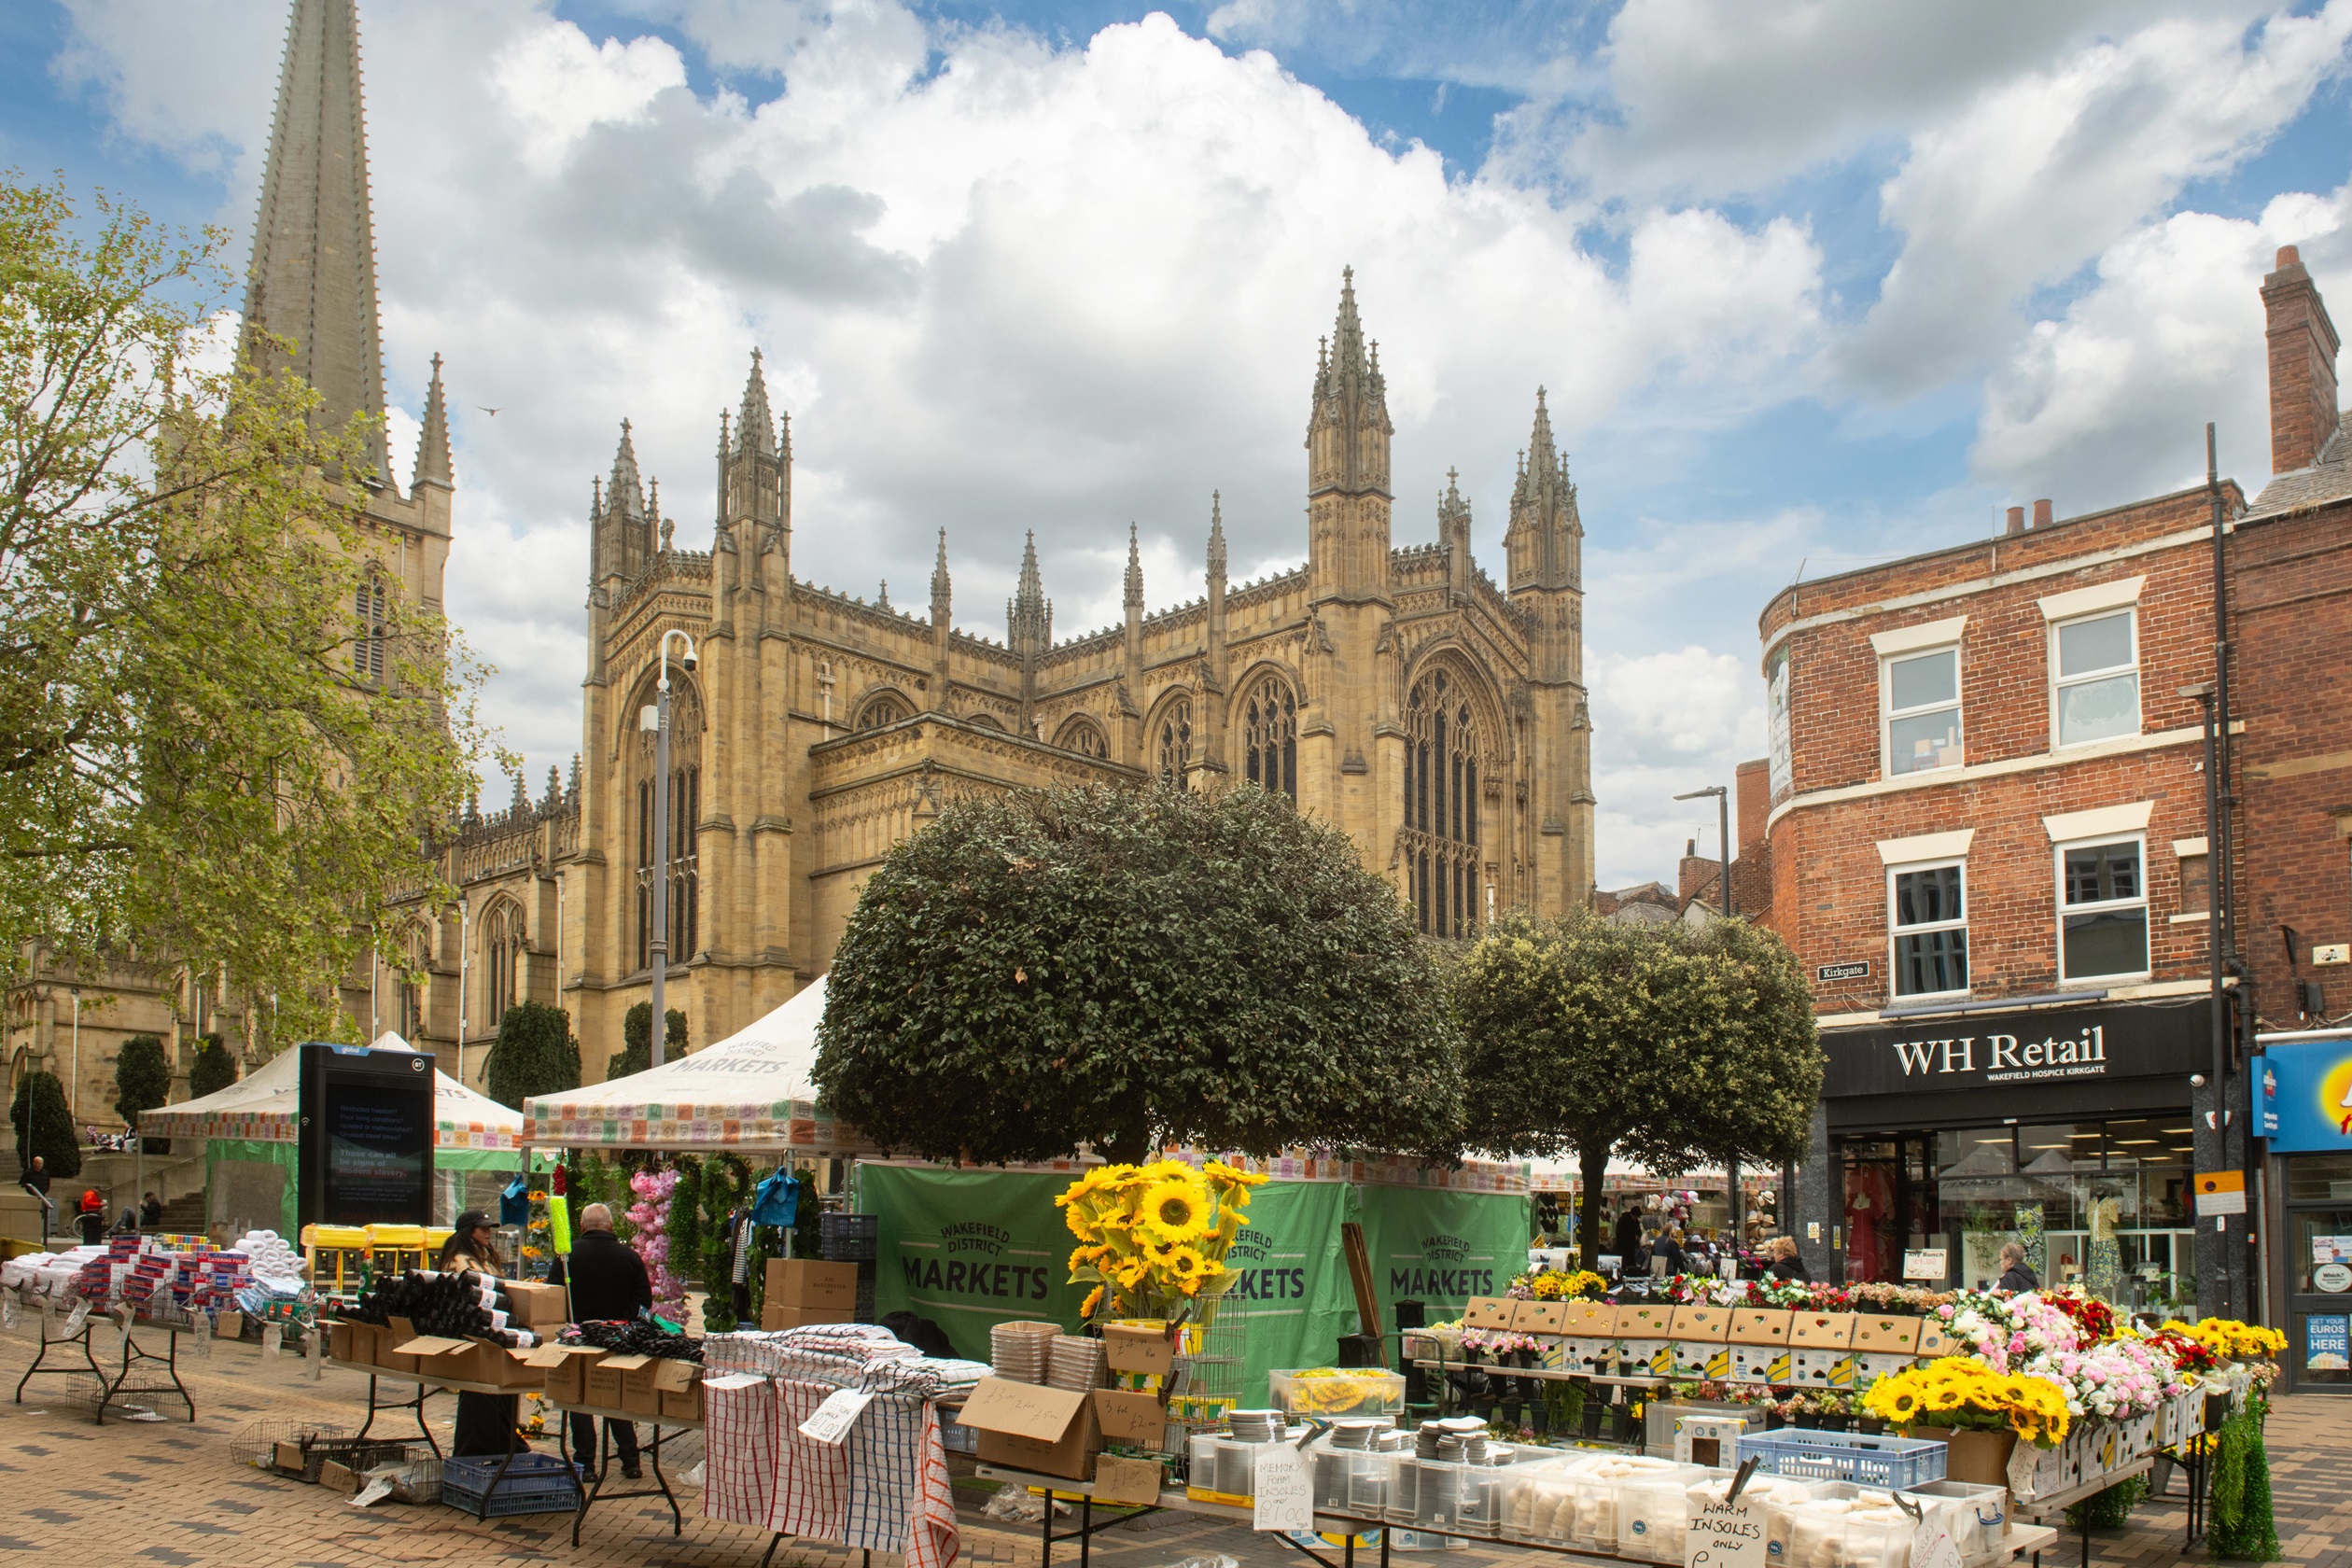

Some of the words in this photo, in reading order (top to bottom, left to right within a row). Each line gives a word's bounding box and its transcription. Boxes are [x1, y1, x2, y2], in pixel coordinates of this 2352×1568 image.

[1823, 966, 1864, 978] Kirkgate
[724, 1046, 766, 1057] DISTRICT
[727, 1040, 777, 1053] WAKEFIELD
[1893, 1037, 1977, 1076] WH
[1987, 1026, 2107, 1068] Retail
[670, 1057, 790, 1073] MARKETS
[1987, 1072, 2030, 1082] WAKEFIELD
[2032, 1069, 2065, 1078] HOSPICE
[2066, 1065, 2106, 1075] KIRKGATE
[340, 1105, 370, 1113] Restricted
[340, 1149, 366, 1157] These
[353, 1158, 375, 1168] signs
[373, 1168, 407, 1177] slavery.
[941, 1222, 1010, 1243] WAKEFIELD
[947, 1239, 1002, 1256] DISTRICT
[1421, 1234, 1470, 1252] WAKEFIELD
[1426, 1248, 1465, 1264] DISTRICT
[902, 1255, 1048, 1300] MARKETS
[1390, 1267, 1493, 1297] MARKETS
[2310, 1324, 2345, 1334] EUROS
[2310, 1338, 2346, 1351] HERE
[824, 1402, 852, 1417] COTTON
[1105, 1400, 1113, 1414] 3
[1259, 1462, 1304, 1473] MEMORY
[1267, 1475, 1291, 1486] FOAM
[1257, 1485, 1307, 1498] INSOLES
[1703, 1503, 1748, 1518] WARM
[1689, 1518, 1760, 1540] INSOLES
[1713, 1540, 1743, 1551] ONLY
